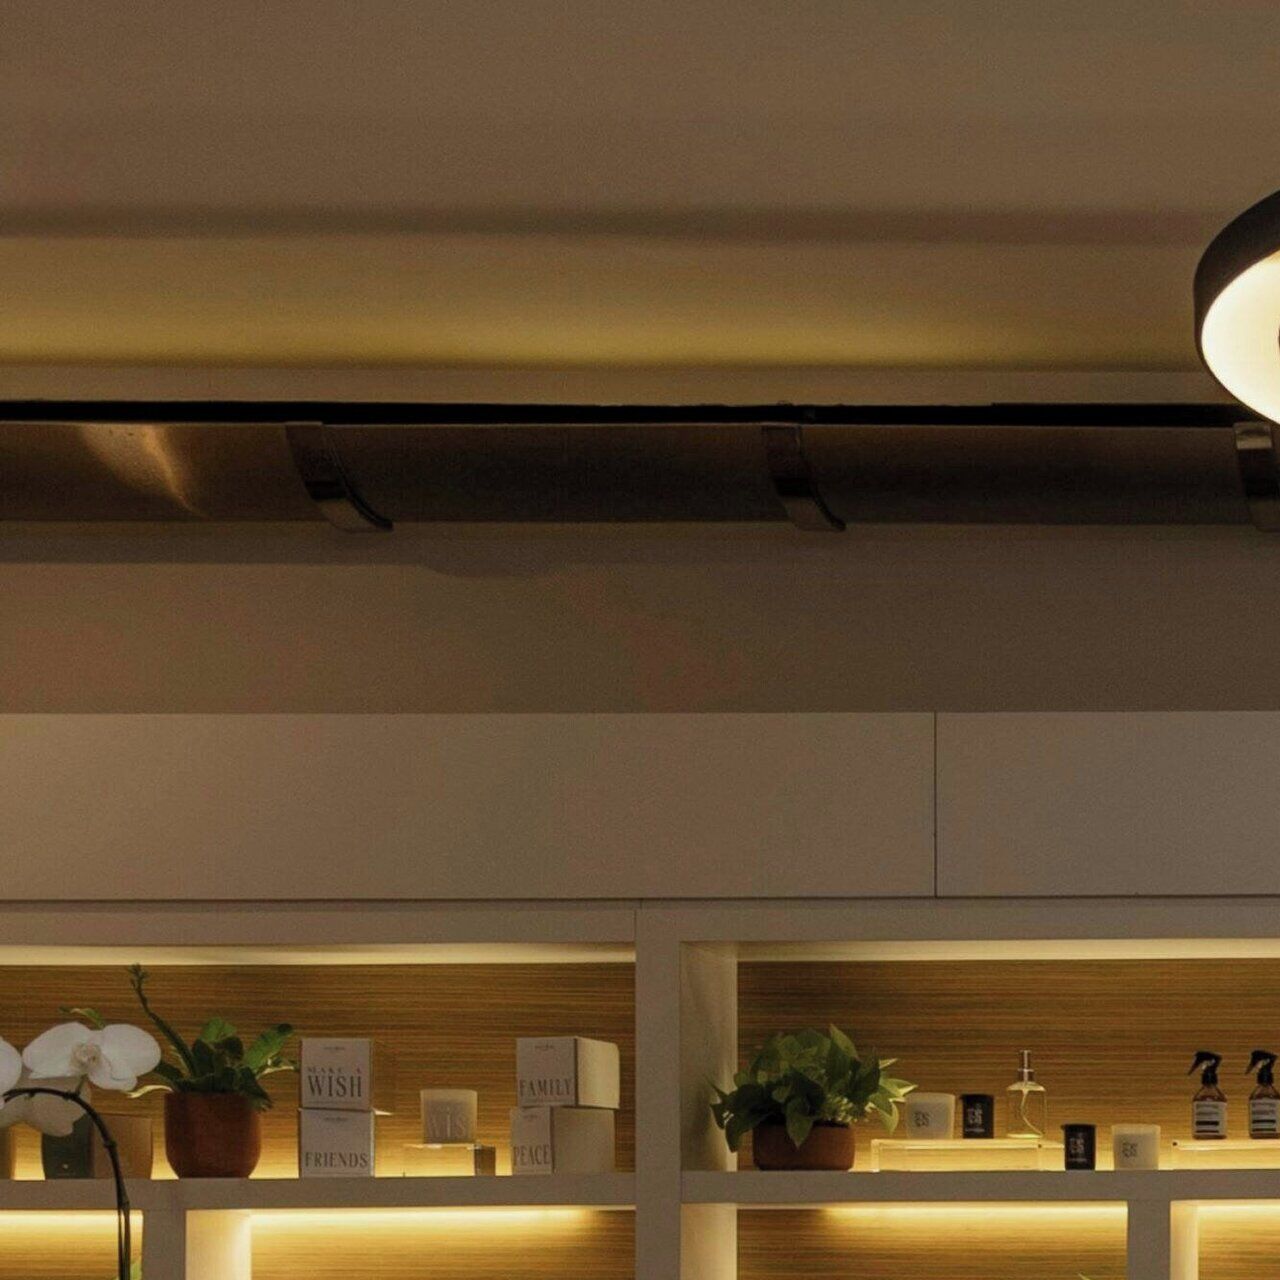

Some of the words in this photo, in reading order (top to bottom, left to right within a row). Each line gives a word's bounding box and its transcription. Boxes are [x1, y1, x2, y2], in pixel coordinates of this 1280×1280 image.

[307, 1075, 362, 1098] WISH
[519, 1079, 573, 1097] FAMILY
[305, 1152, 369, 1168] FRIENDS
[513, 1144, 551, 1167] PEACE
